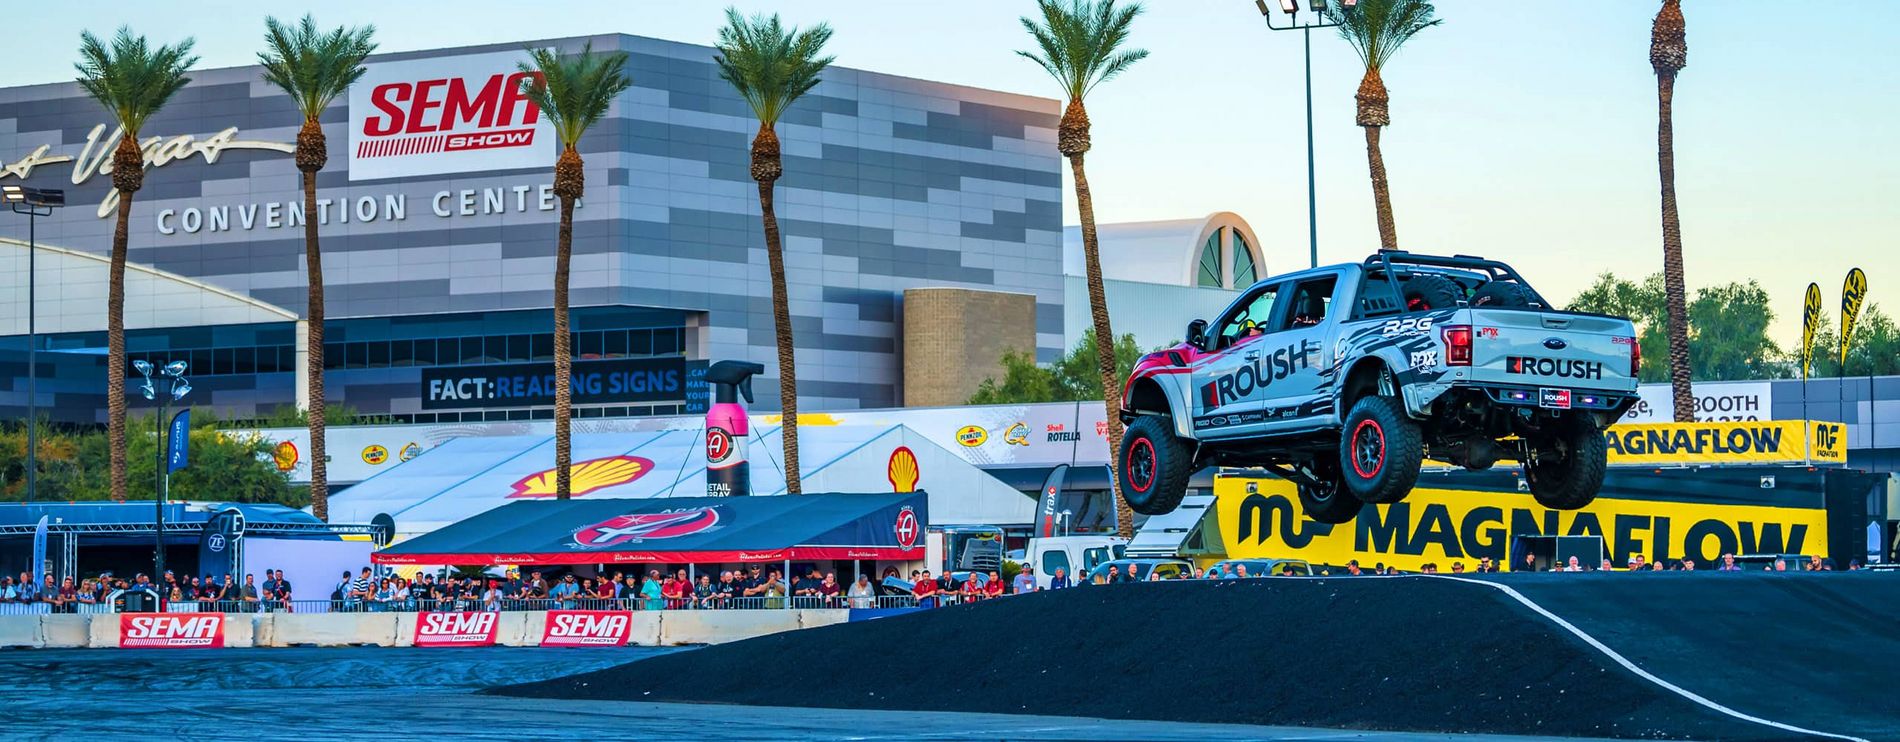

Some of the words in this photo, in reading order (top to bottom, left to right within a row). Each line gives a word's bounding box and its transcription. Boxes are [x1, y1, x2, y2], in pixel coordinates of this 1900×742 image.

[363, 71, 548, 137] SEMA
[448, 131, 531, 148] SHOW
[157, 193, 406, 235] CONVENTION
[1383, 318, 1433, 333] RPG
[1410, 351, 1437, 367] FOX
[1521, 357, 1601, 380] ROUSH
[608, 369, 678, 394] SIGNS
[1217, 338, 1309, 407] ROUSH
[1544, 394, 1568, 402] ROUSH
[1048, 432, 1081, 442] ROTELLA
[1606, 427, 1783, 455] AGNAFLOW
[210, 537, 224, 549] ZF
[128, 617, 220, 638] SEMA
[421, 613, 496, 633] SEMA
[550, 614, 628, 637] SEMA
